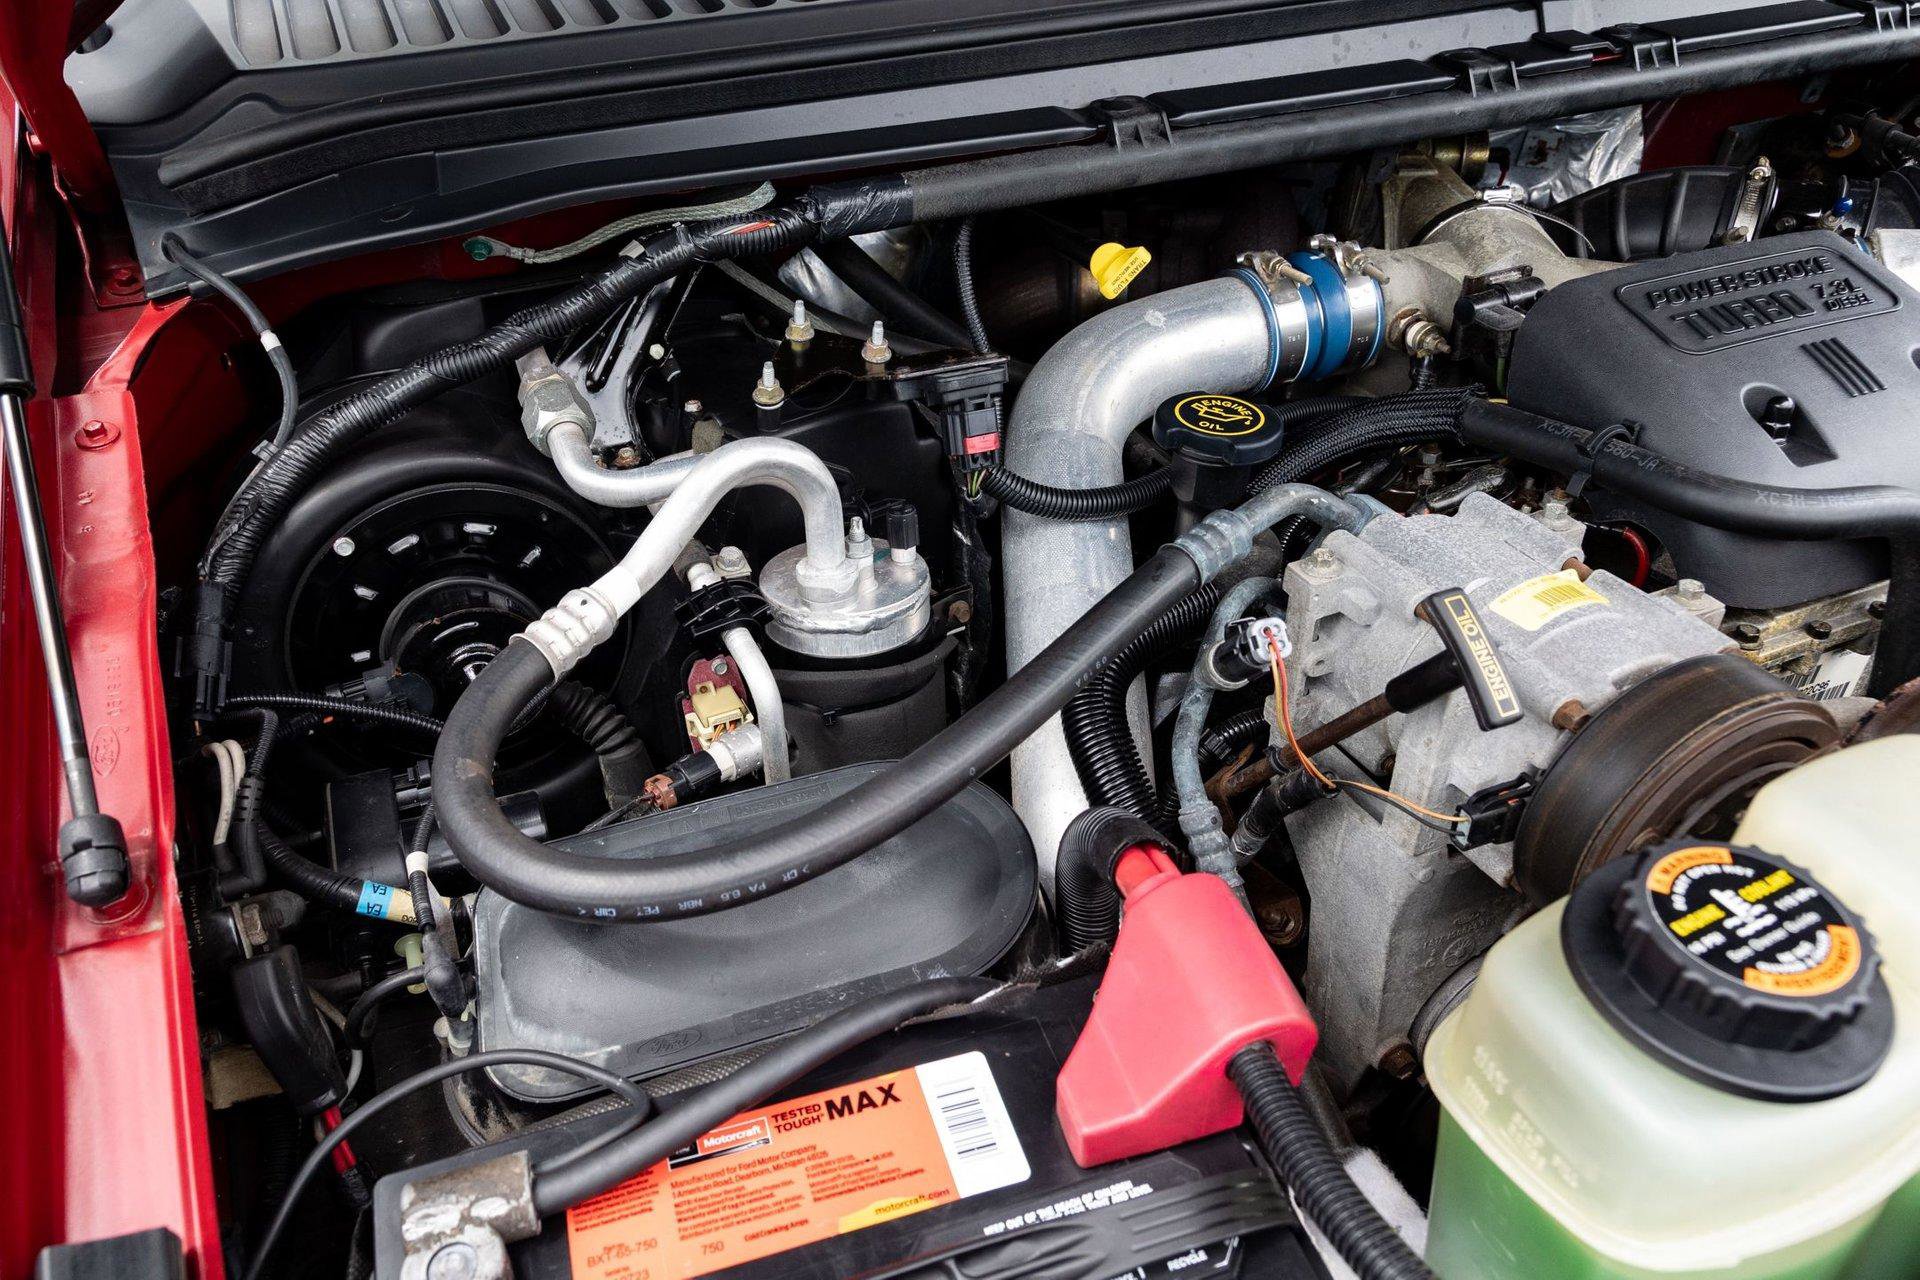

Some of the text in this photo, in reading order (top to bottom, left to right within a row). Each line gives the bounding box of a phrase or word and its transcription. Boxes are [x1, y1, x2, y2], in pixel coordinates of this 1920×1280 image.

[1645, 255, 1836, 311] POWER STROKE
[1668, 288, 1818, 341] TURBO
[1822, 292, 1876, 312] DIESEL
[1200, 399, 1253, 417] ENGINE
[1198, 420, 1226, 431] OIL
[1456, 608, 1479, 637] OIL
[1471, 637, 1509, 700] ENGINE
[372, 883, 388, 896] EA
[366, 901, 383, 917] EA
[678, 898, 703, 911] NBR
[771, 1103, 821, 1124] TESTED
[824, 1081, 902, 1121] MAX
[702, 1125, 763, 1149] Motorcraft
[670, 1168, 726, 1189] Manufactured
[725, 1164, 737, 1174] for
[737, 1159, 756, 1171] Ford
[756, 1153, 780, 1166] Motor
[780, 1142, 818, 1161] Company
[676, 1182, 713, 1197] American
[771, 1156, 806, 1172] Michigan
[874, 1188, 950, 1216] motorcraft.com
[700, 1240, 725, 1257] 750
[789, 1217, 809, 1229] Amps
